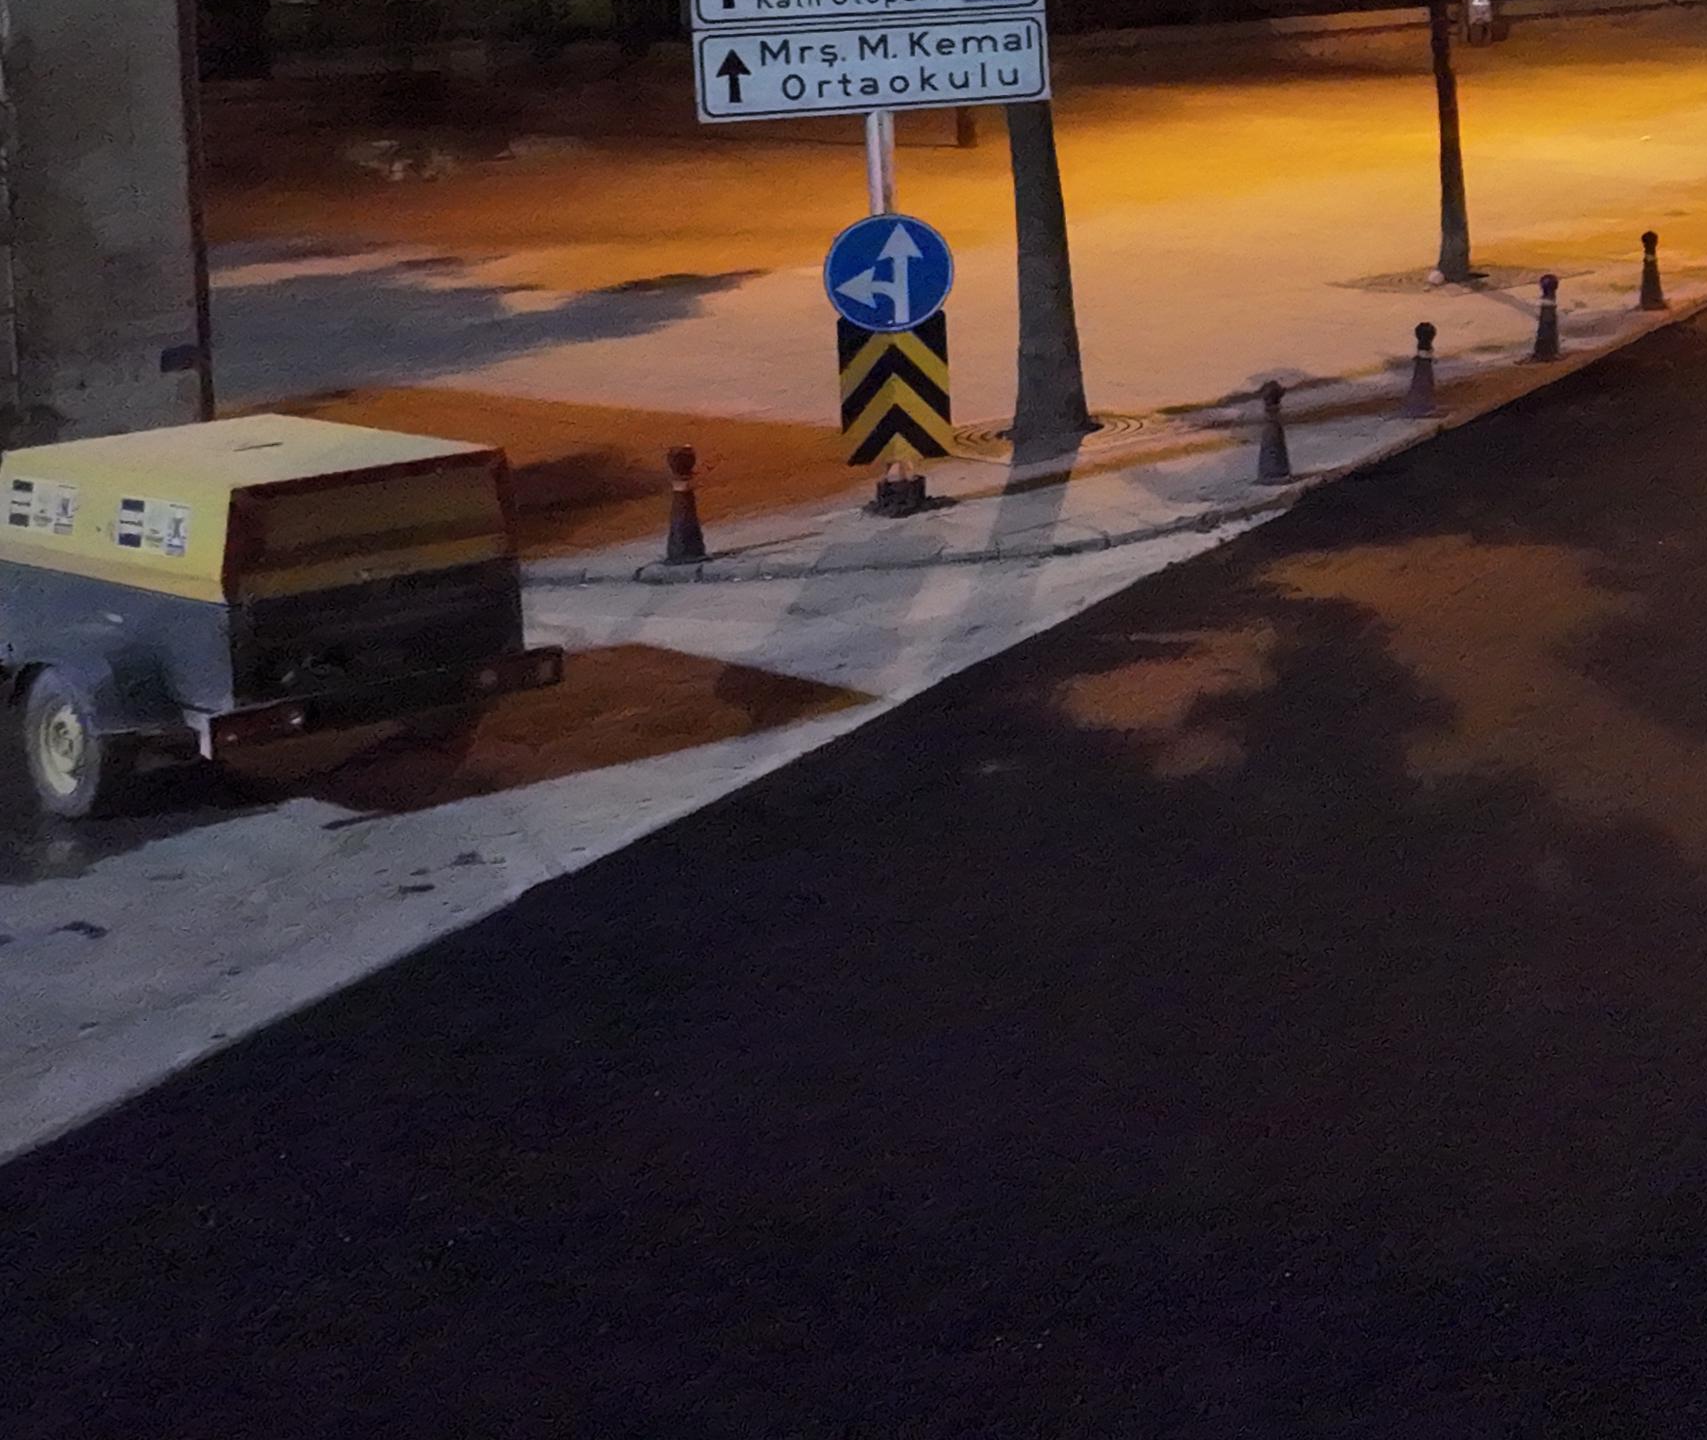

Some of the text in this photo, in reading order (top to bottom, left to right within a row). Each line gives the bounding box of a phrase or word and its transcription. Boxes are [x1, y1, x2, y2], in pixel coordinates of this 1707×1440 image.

[760, 25, 1033, 68] Mrş. M. Kemal
[782, 62, 1019, 101] Ortaokulu
